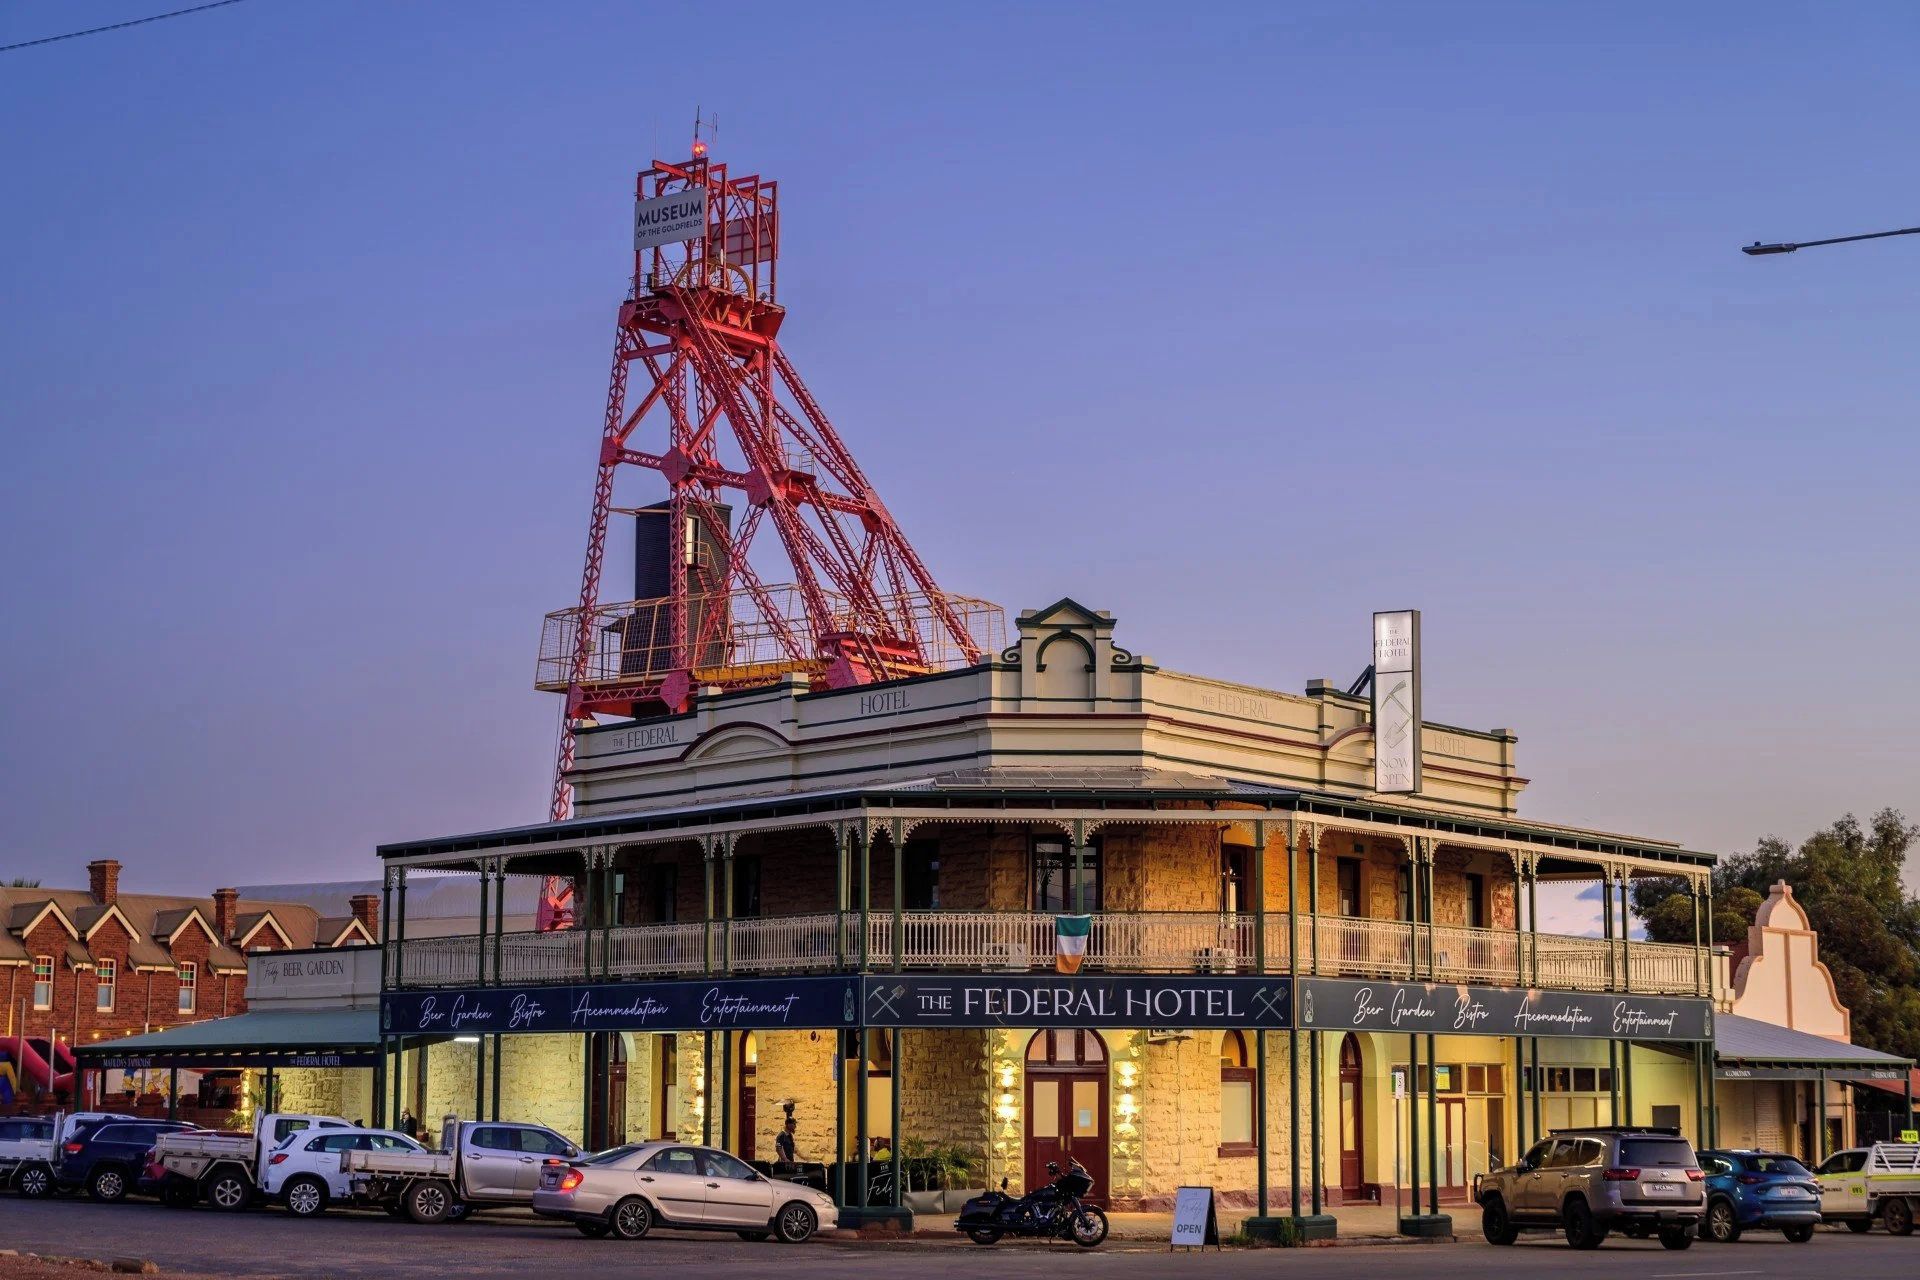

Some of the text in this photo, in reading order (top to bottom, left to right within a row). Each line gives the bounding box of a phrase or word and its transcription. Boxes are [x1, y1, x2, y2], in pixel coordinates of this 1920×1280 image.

[638, 200, 702, 227] MUSEUM
[637, 219, 703, 238] OF THE GOLDFIELDS
[1376, 638, 1410, 647] FEDERAL
[1379, 648, 1408, 658] HOTEL
[860, 690, 910, 715] HOTEL
[1202, 692, 1272, 721] THE FEDERAL
[612, 726, 679, 749] THE FEDERAL
[1433, 734, 1468, 756] HOTEL
[1380, 757, 1409, 769] NOW
[1379, 772, 1410, 785] OPEN
[283, 962, 303, 977] BEER
[307, 959, 344, 976] GARDEN
[419, 987, 800, 1029] Beer Garden Bistro Accommodation Entertainment
[917, 987, 1245, 1017] THE FEDERAL HOTEL
[1353, 987, 1679, 1034] Beer Garden Bistro Accommodation Entertainment
[297, 1056, 320, 1066] FEDERAL
[321, 1056, 341, 1066] HOTEL
[1176, 1224, 1202, 1234] OPEN
